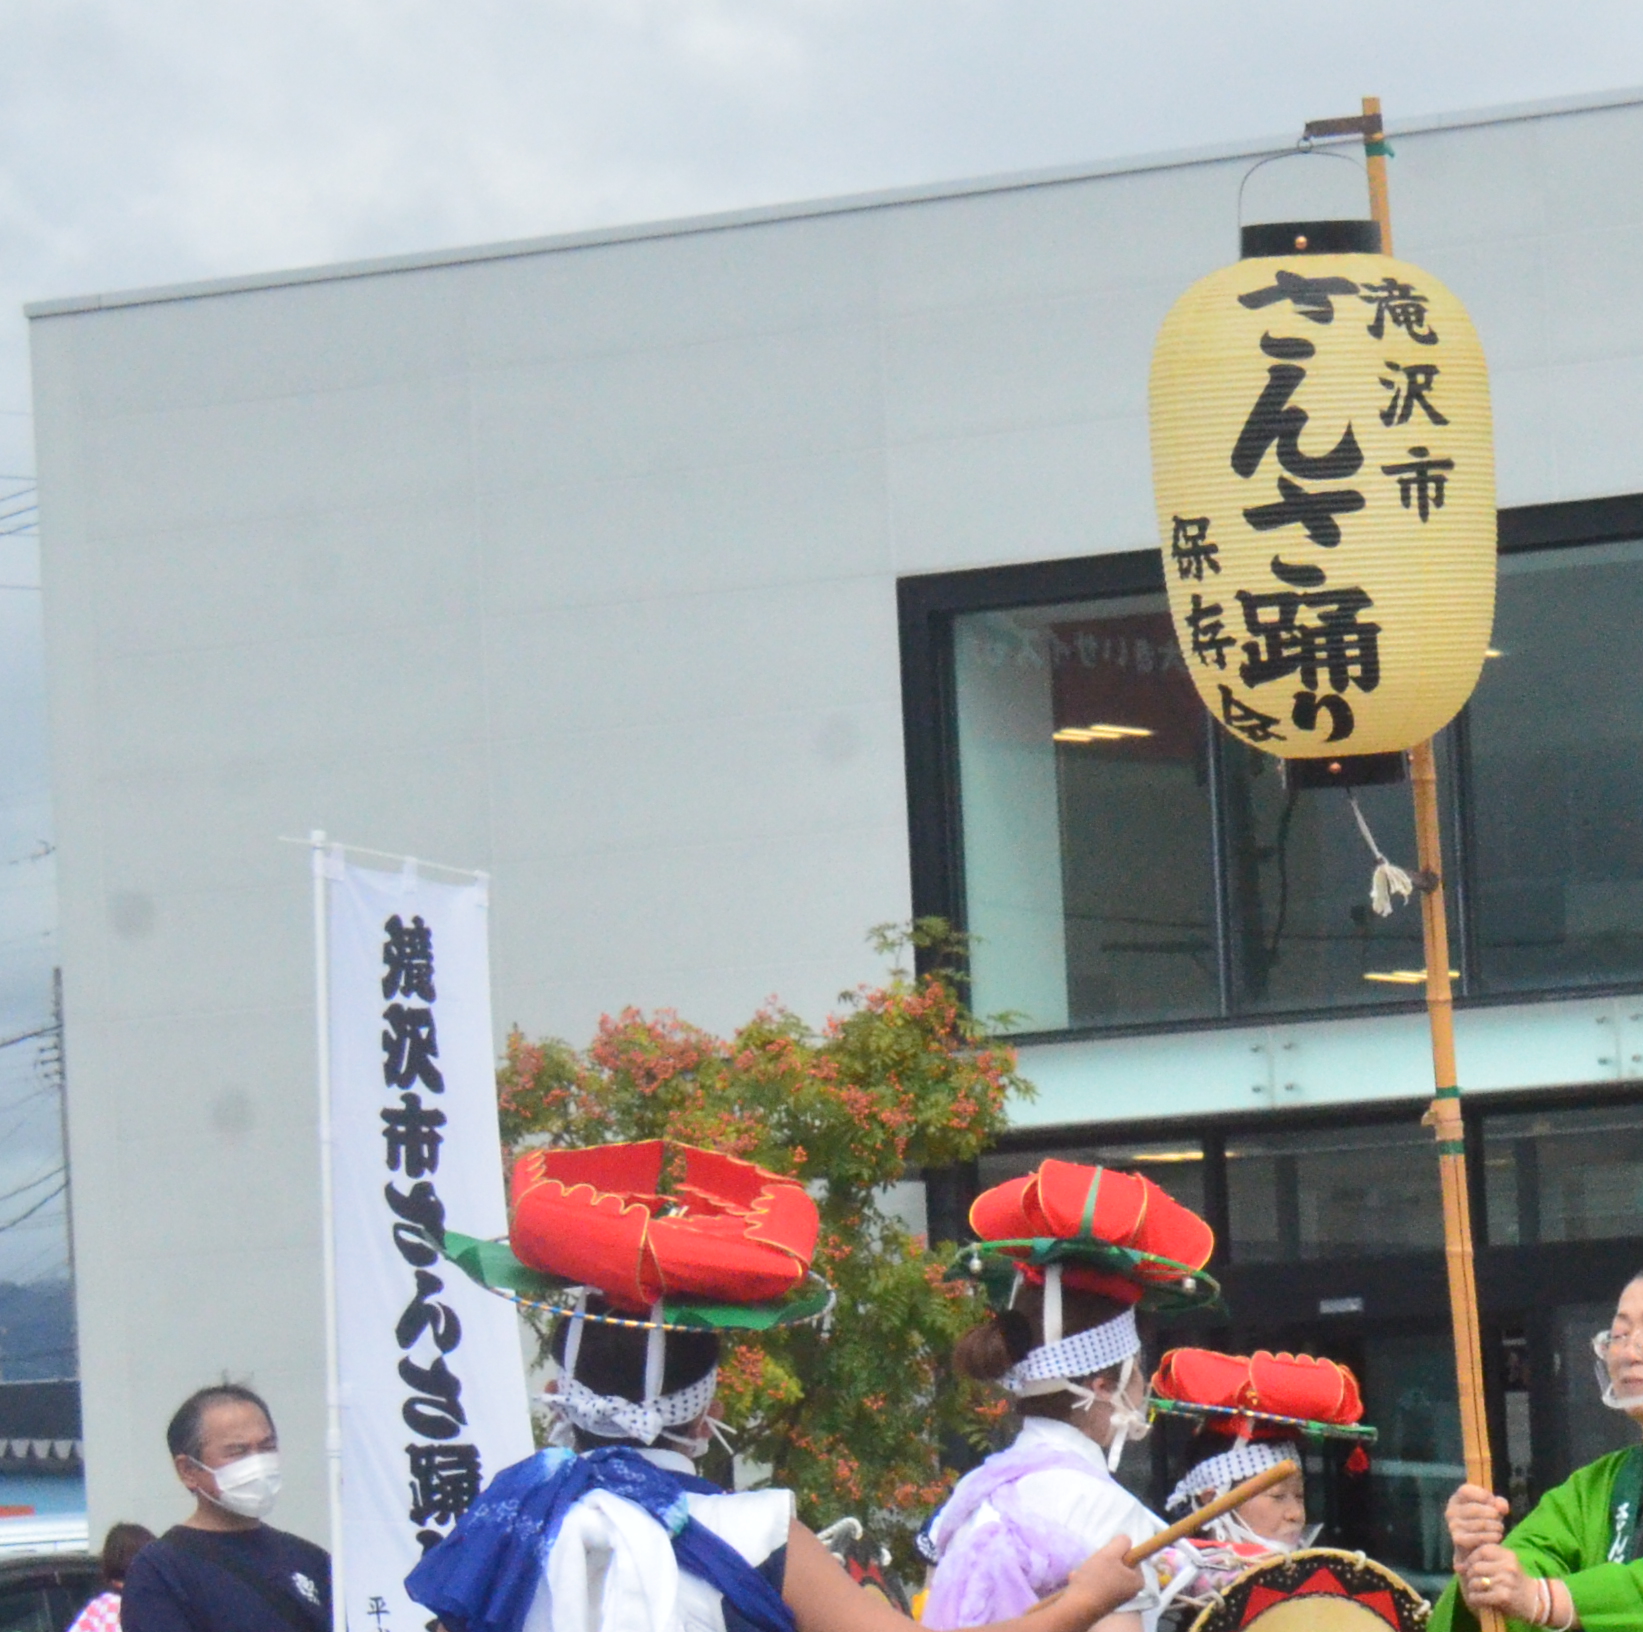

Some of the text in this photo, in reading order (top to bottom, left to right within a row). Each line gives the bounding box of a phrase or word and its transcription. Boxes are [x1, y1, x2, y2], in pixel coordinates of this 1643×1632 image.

[1230, 269, 1382, 743] さんさ踊り
[1359, 277, 1454, 523] 滝沢市
[1171, 515, 1287, 742] 保存会
